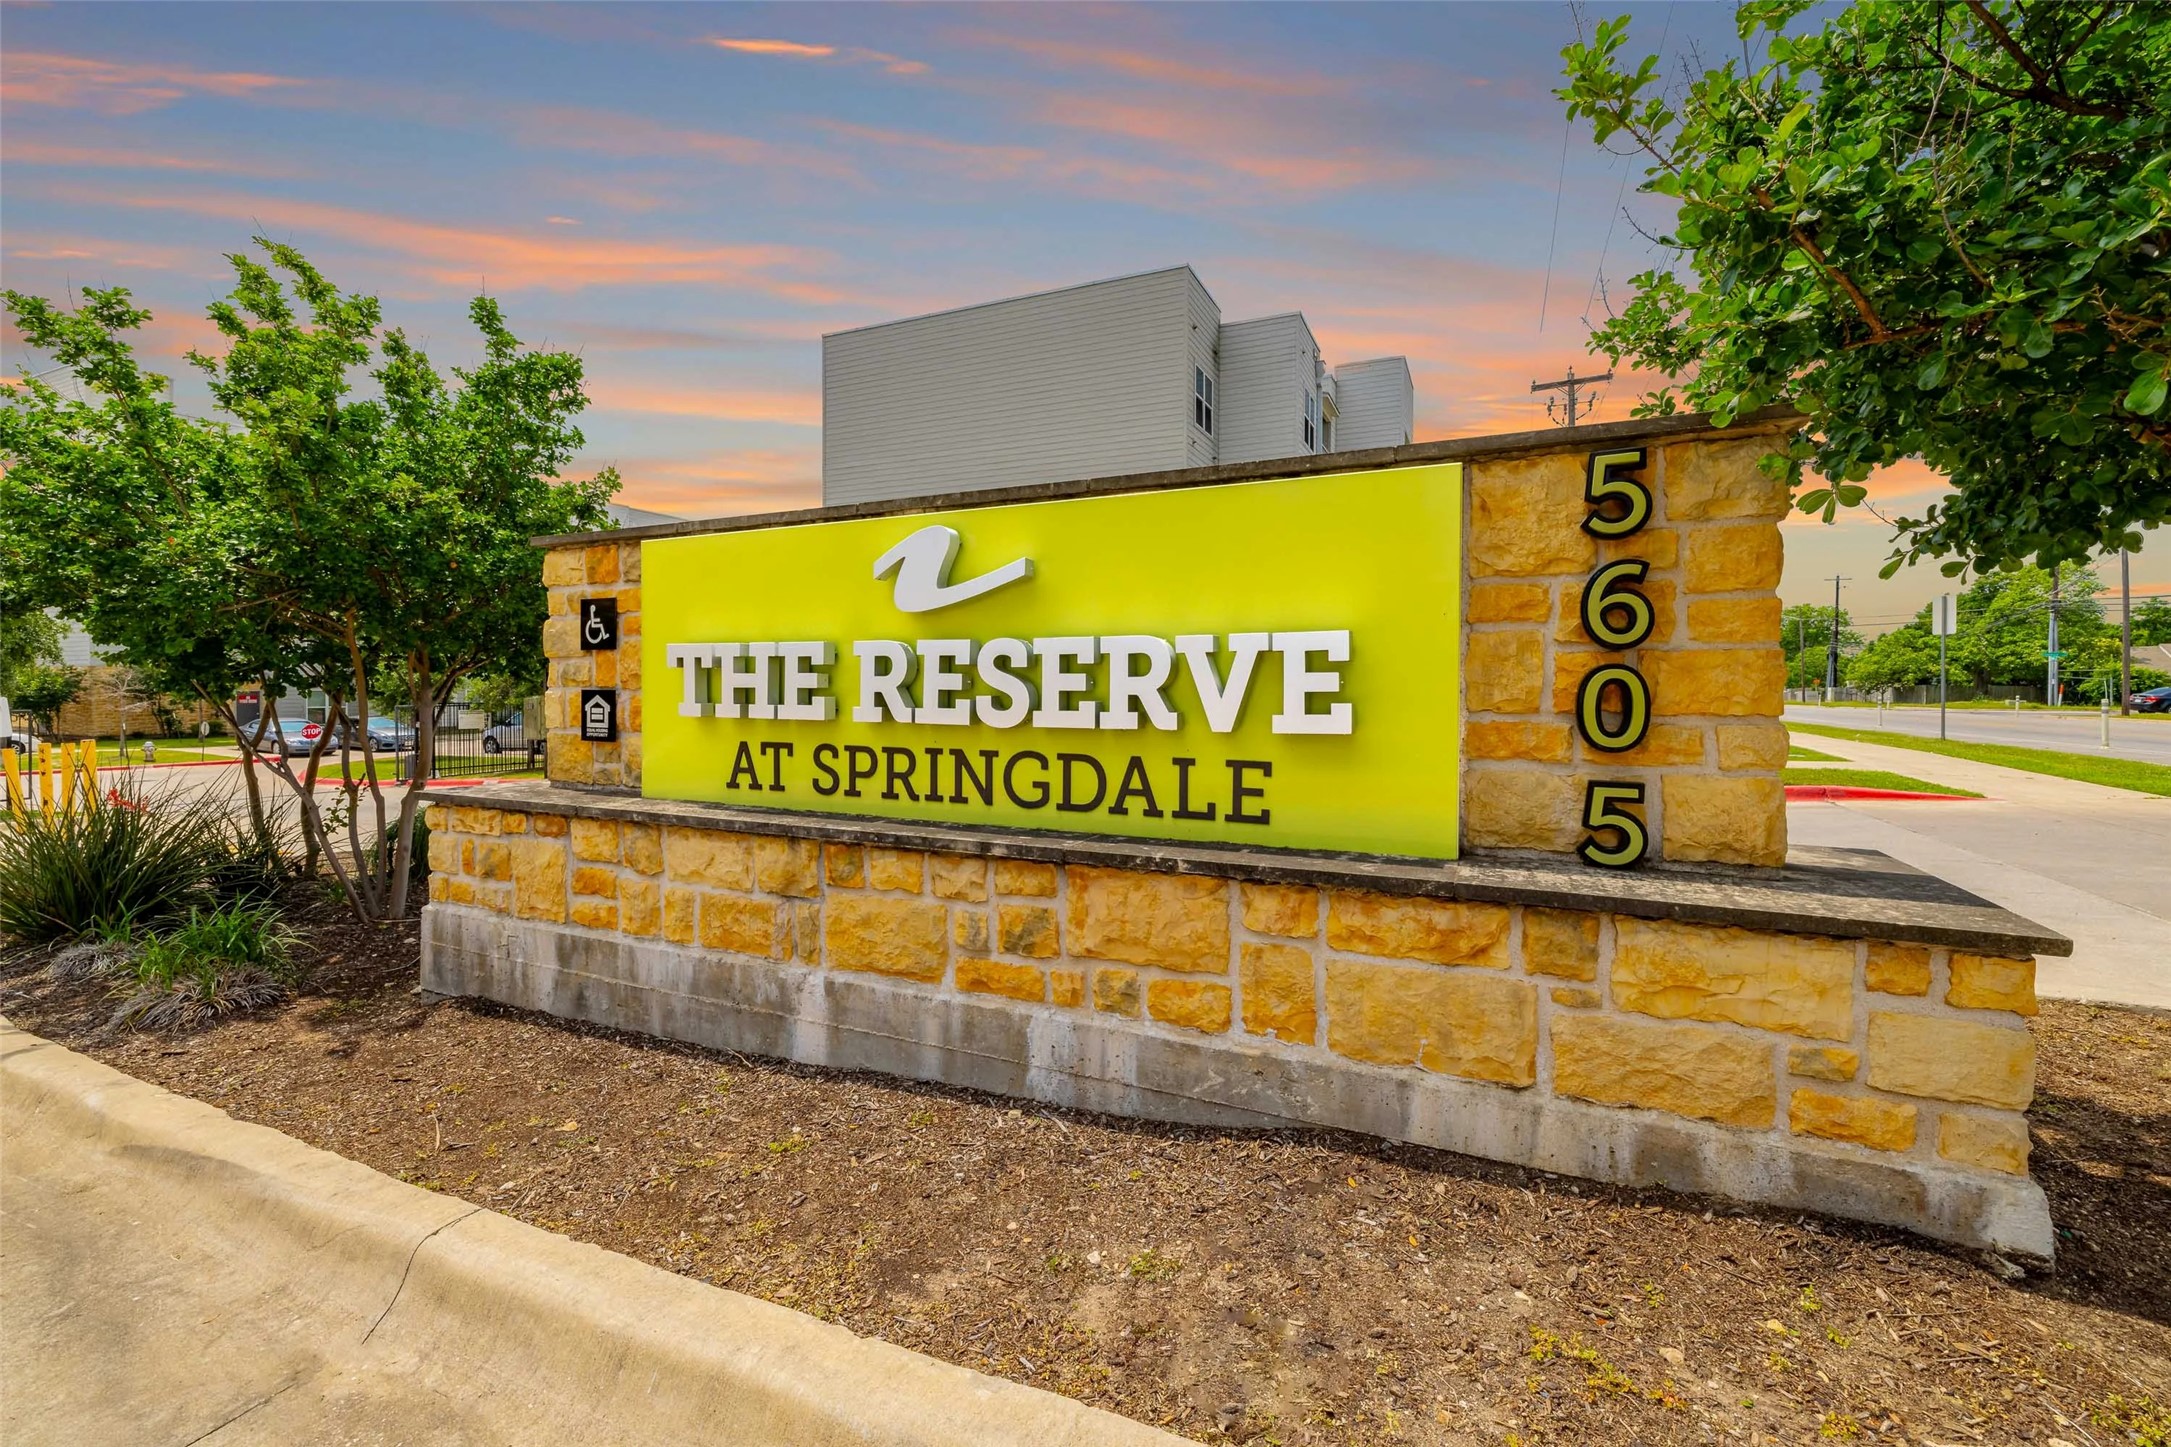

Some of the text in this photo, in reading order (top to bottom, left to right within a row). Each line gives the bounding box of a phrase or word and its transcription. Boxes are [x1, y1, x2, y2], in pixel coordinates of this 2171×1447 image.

[666, 629, 1353, 735] THE RESERVE
[1576, 446, 1656, 871] 5605
[302, 728, 321, 736] STOP
[725, 740, 1273, 825] AT SPRINGDALE
